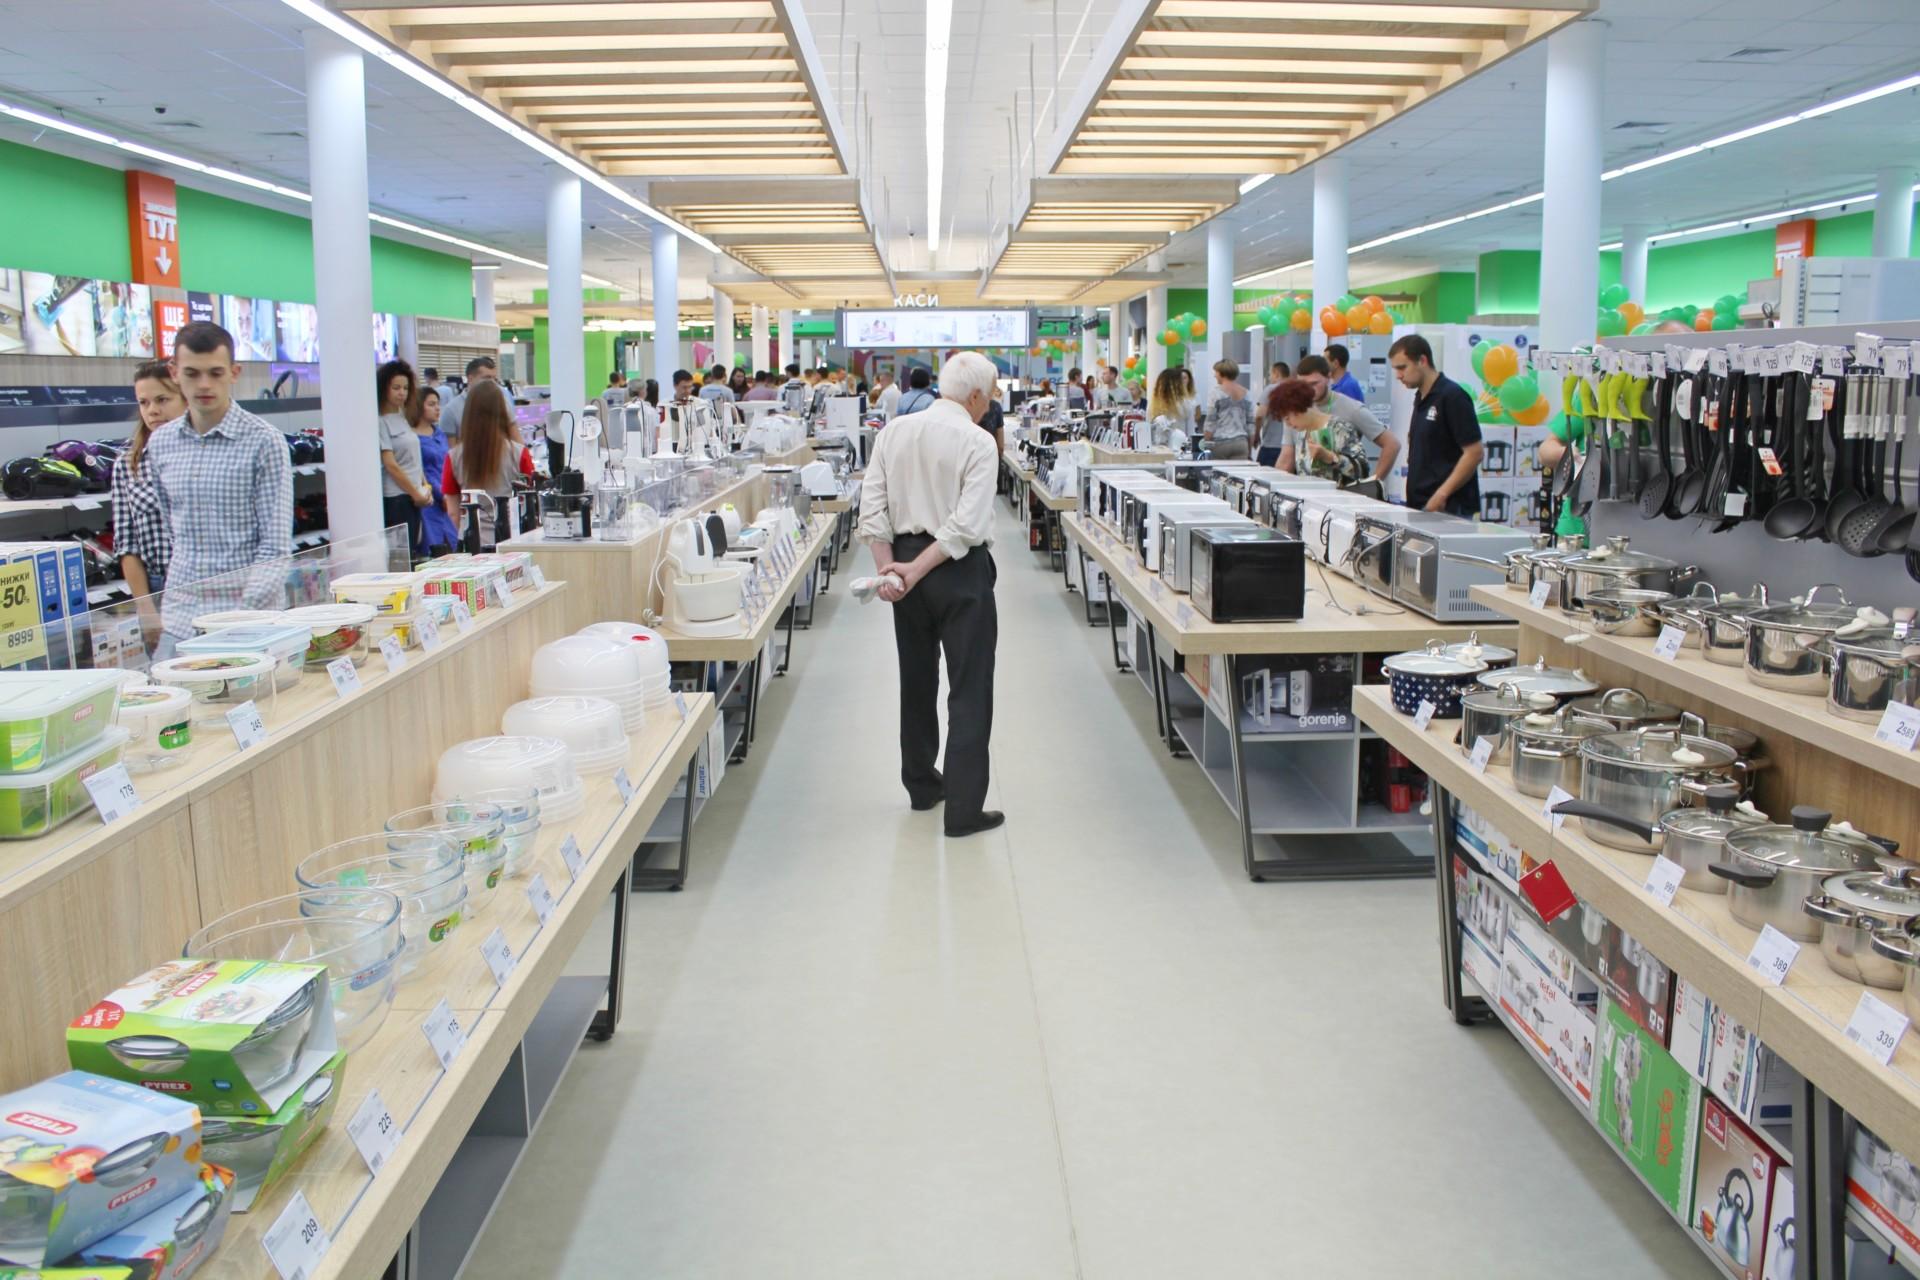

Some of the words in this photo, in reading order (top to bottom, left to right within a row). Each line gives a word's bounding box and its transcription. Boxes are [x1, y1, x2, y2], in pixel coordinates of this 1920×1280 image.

[144, 212, 177, 242] ТУТ
[894, 293, 939, 307] КАСИ
[164, 306, 185, 330] ЩЕ
[1801, 354, 1812, 367] 125
[1868, 347, 1877, 359] 79
[1766, 359, 1777, 369] 125
[1830, 357, 1841, 369] 125
[1897, 359, 1907, 371] 79
[8, 629, 34, 648] 8999
[1299, 712, 1347, 728] gorenje
[119, 784, 135, 799] 179
[1772, 957, 1788, 973] 389
[1538, 976, 1557, 1001] Tefal
[1876, 1030, 1895, 1049] 339
[144, 1081, 187, 1091] PYREX
[378, 1112, 392, 1135] 225
[110, 1184, 152, 1207] PYREX
[301, 1218, 318, 1244] 209
